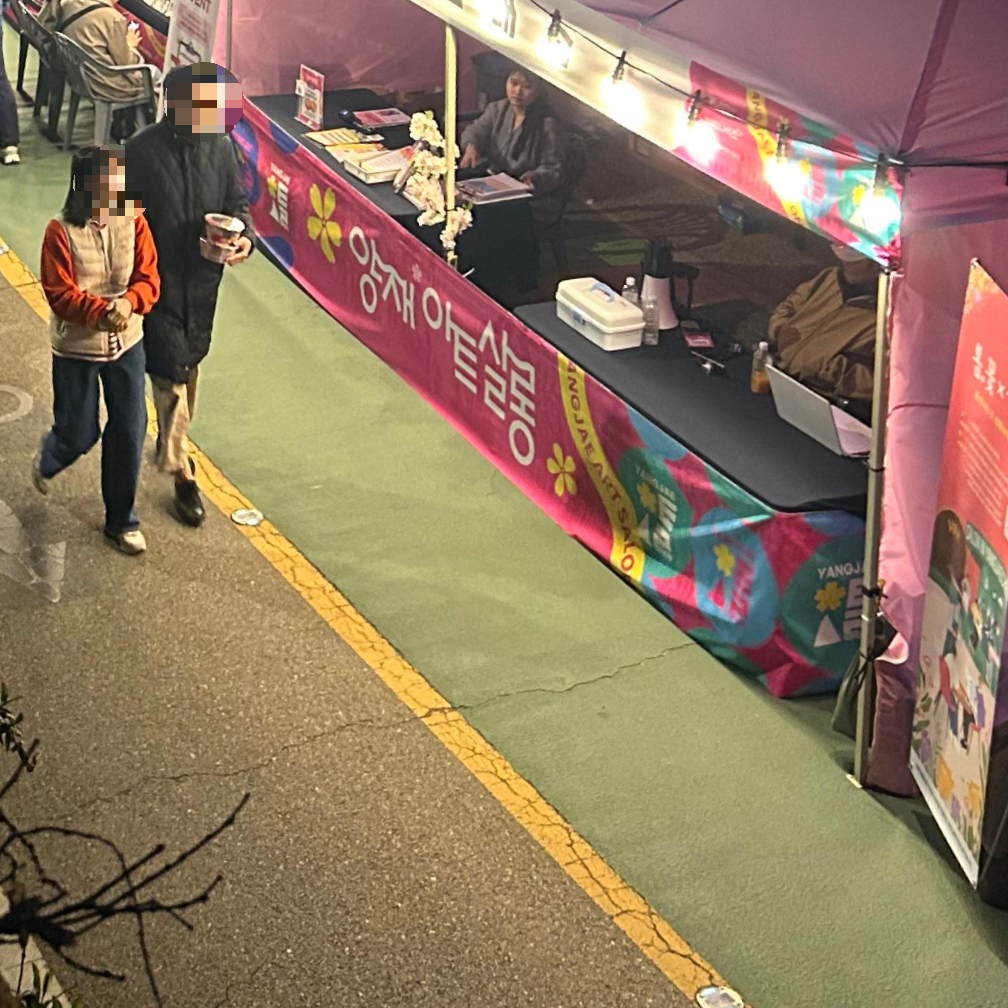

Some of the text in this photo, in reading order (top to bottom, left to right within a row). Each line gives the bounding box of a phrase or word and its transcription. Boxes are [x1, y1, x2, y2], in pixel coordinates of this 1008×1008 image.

[592, 462, 622, 502] ART
[617, 509, 636, 577] SALO
[817, 562, 865, 580] YANGJ
